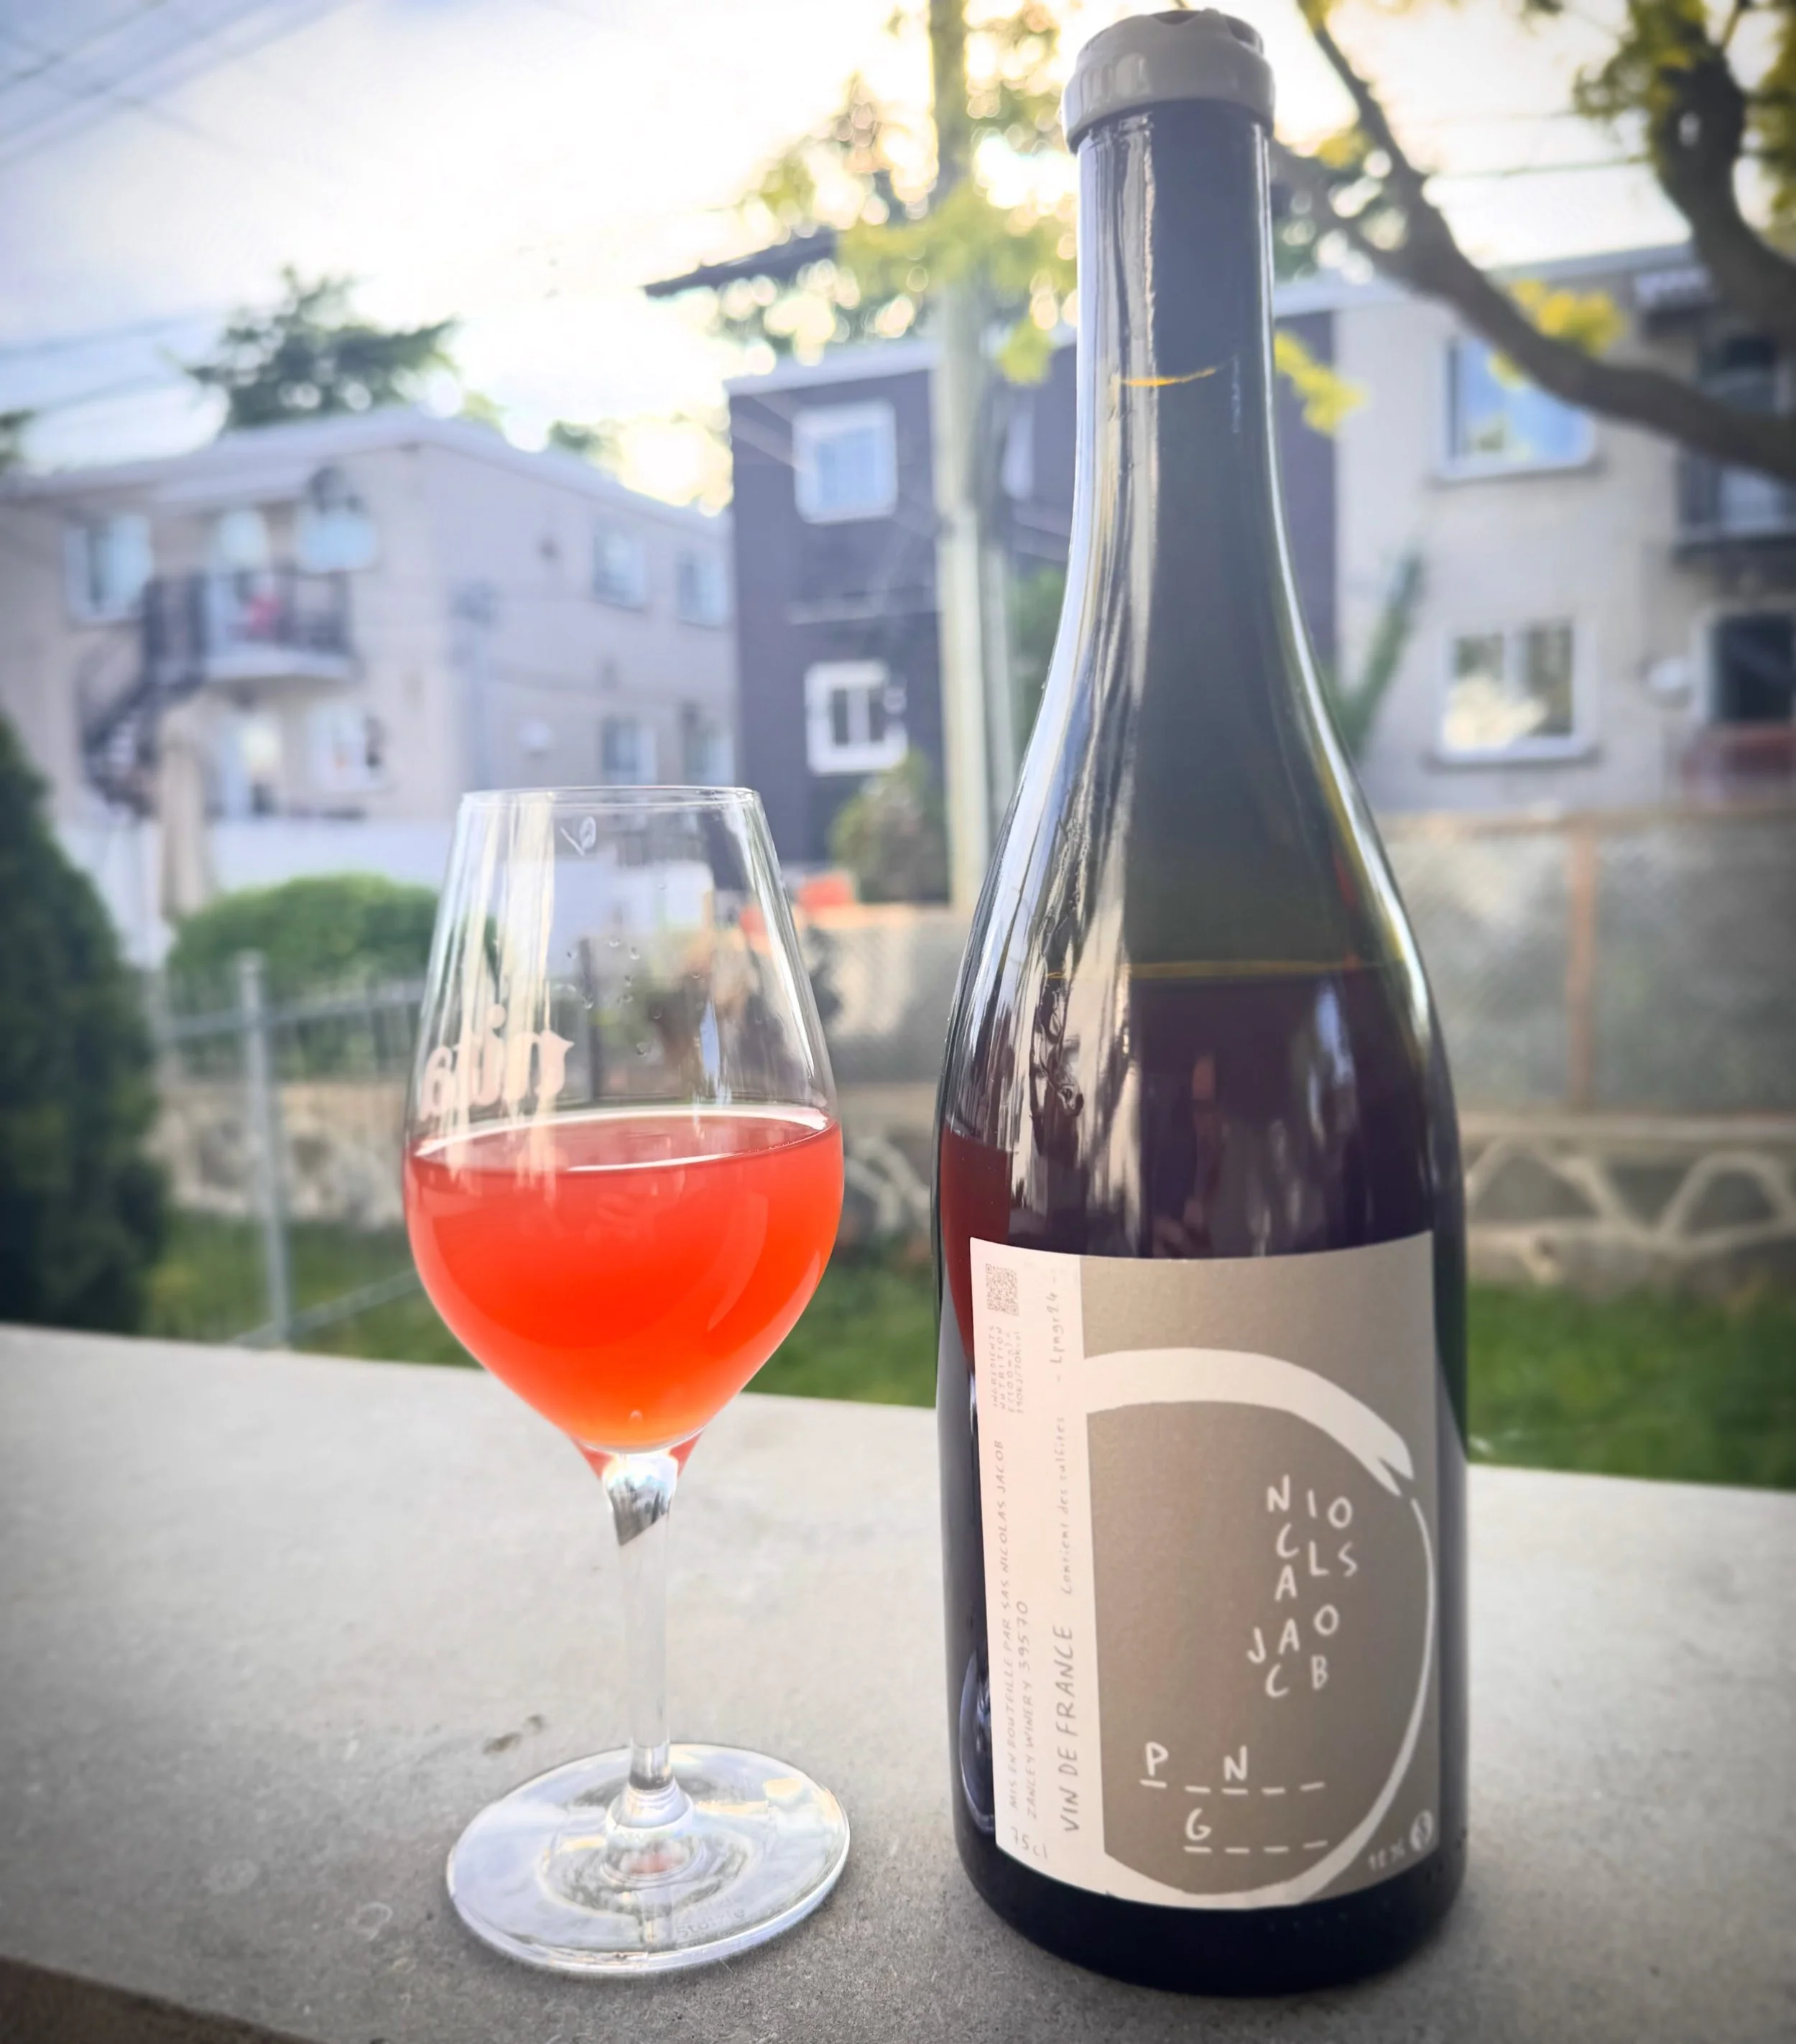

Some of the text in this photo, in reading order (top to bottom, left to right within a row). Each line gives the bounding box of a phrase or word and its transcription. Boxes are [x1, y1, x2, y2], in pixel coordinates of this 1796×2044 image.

[1057, 1489, 1069, 1515] des
[994, 1440, 1018, 1810] MIS EN BOUTEILLE PAR SAS NICOLAS JACOB
[1016, 1601, 1030, 1673] 39570
[1022, 1680, 1034, 1748] WINERY
[1052, 1624, 1080, 1832] VIN DE FRANCE
